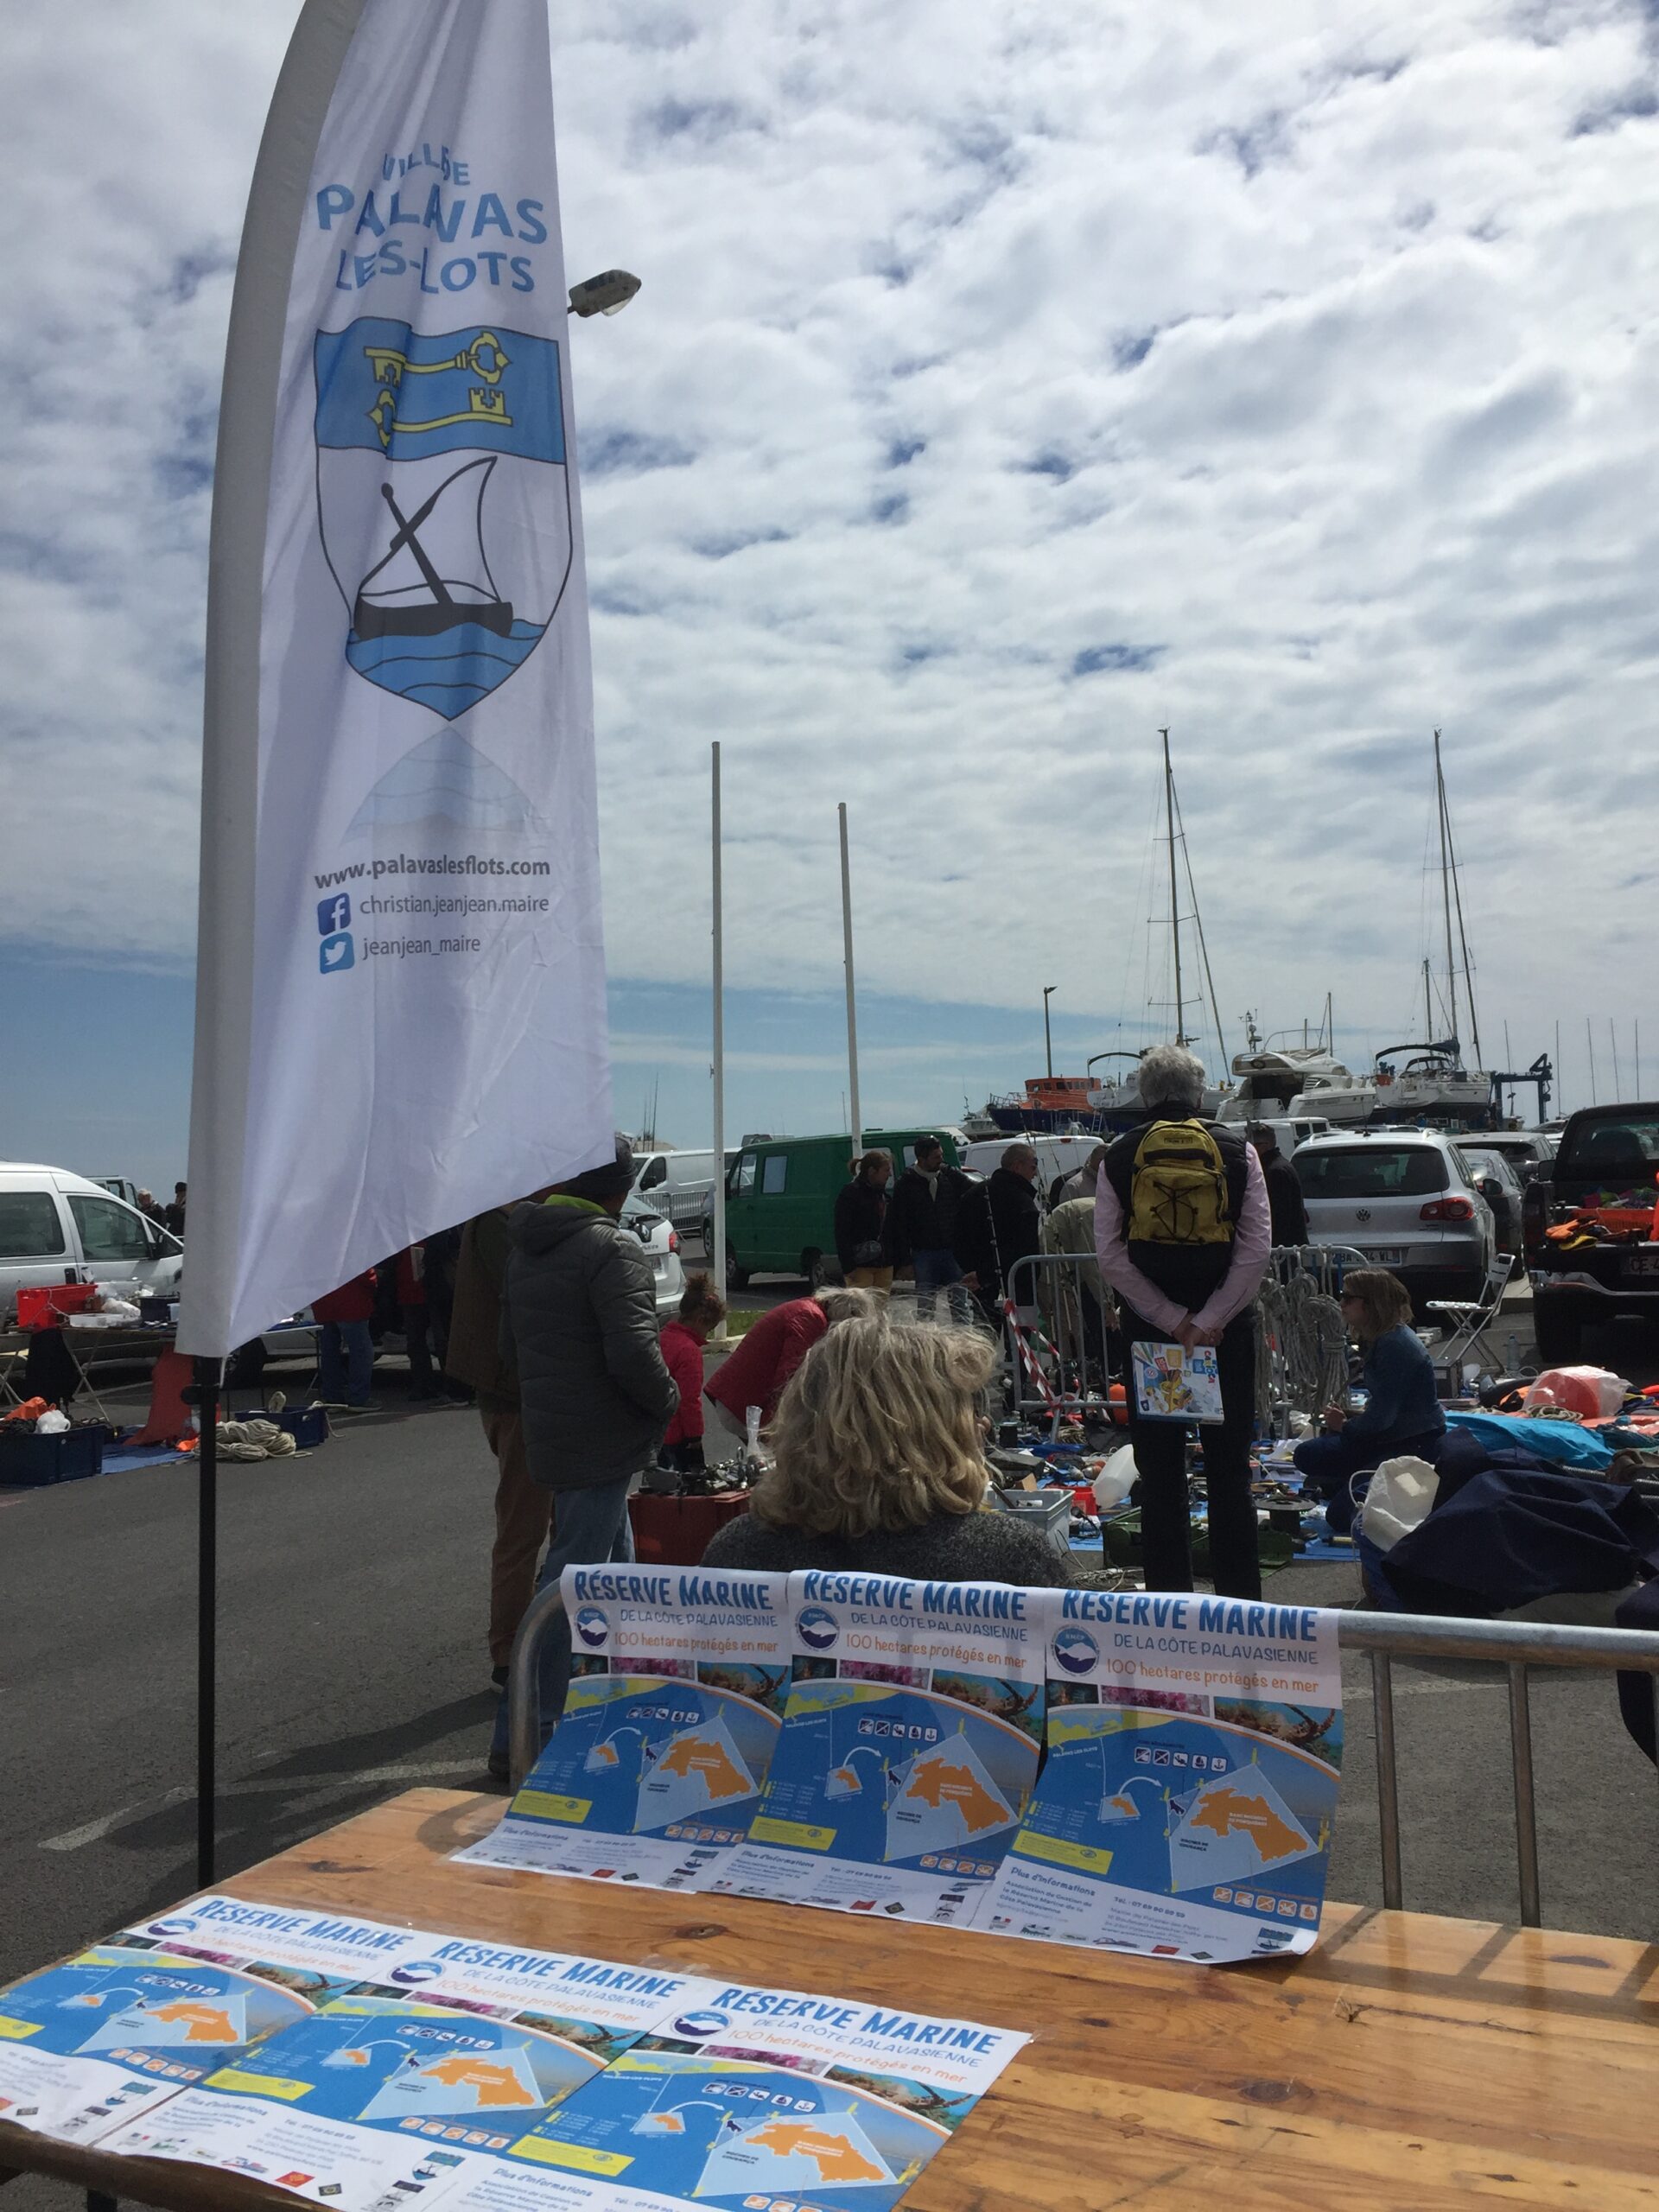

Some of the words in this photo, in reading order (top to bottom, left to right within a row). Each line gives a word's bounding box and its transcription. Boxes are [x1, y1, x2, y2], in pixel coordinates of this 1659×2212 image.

[315, 853, 551, 889] www.palavaslesflots.com
[359, 894, 550, 918] christian.jeanjean.maire
[362, 934, 481, 961] jeanjean_maire
[575, 1570, 673, 1605] RÉSERVE
[678, 1574, 774, 1610] MARINE
[922, 1582, 1027, 1621] MARINE
[620, 1609, 636, 1621] DE
[638, 1610, 652, 1622] LA
[686, 1612, 779, 1627] PALAVASIENNE
[850, 1612, 869, 1624] DE
[871, 1613, 887, 1624] LA
[927, 1619, 1028, 1642] PALAVASIENNE
[1198, 1599, 1318, 1642] MARINE
[614, 1631, 639, 1645] 100
[641, 1632, 689, 1647] hectares
[690, 1637, 738, 1655] protégés
[741, 1641, 754, 1651] en
[757, 1642, 777, 1652] mer
[847, 1633, 872, 1649] 100
[874, 1636, 926, 1655] hectares
[929, 1645, 984, 1664] protégés
[987, 1653, 1001, 1664] en
[1004, 1655, 1027, 1669] mer
[1114, 1633, 1133, 1648] DE
[1136, 1636, 1154, 1649] LA
[1158, 1637, 1198, 1656] CÔTE
[1201, 1642, 1319, 1665] PALAVASIENNE
[1107, 1658, 1136, 1675] 100
[1140, 1661, 1201, 1681] hectares
[1205, 1671, 1268, 1690] protégés
[1271, 1678, 1288, 1690] en
[1292, 1680, 1319, 1693] mer
[1010, 1866, 1030, 1878] Plus
[190, 1900, 311, 1933] RÉSERVE
[300, 1919, 415, 1951] MARINE
[430, 1941, 566, 1977] RÉSERVE
[560, 1961, 687, 1999] MARINE
[545, 1982, 661, 2010] PALAVASIENNE
[710, 1987, 861, 2030] RÉSERVE
[860, 2011, 1002, 2055] MARINE
[728, 2030, 764, 2040] 100
[765, 2032, 833, 2055] hectares
[833, 2049, 908, 2071] protégés
[911, 2064, 932, 2075] en
[934, 2068, 969, 2083] mer
[778, 2019, 799, 2029] LA
[849, 2036, 983, 2069] PALAVASIENNE
[492, 2167, 516, 2181] Plus
